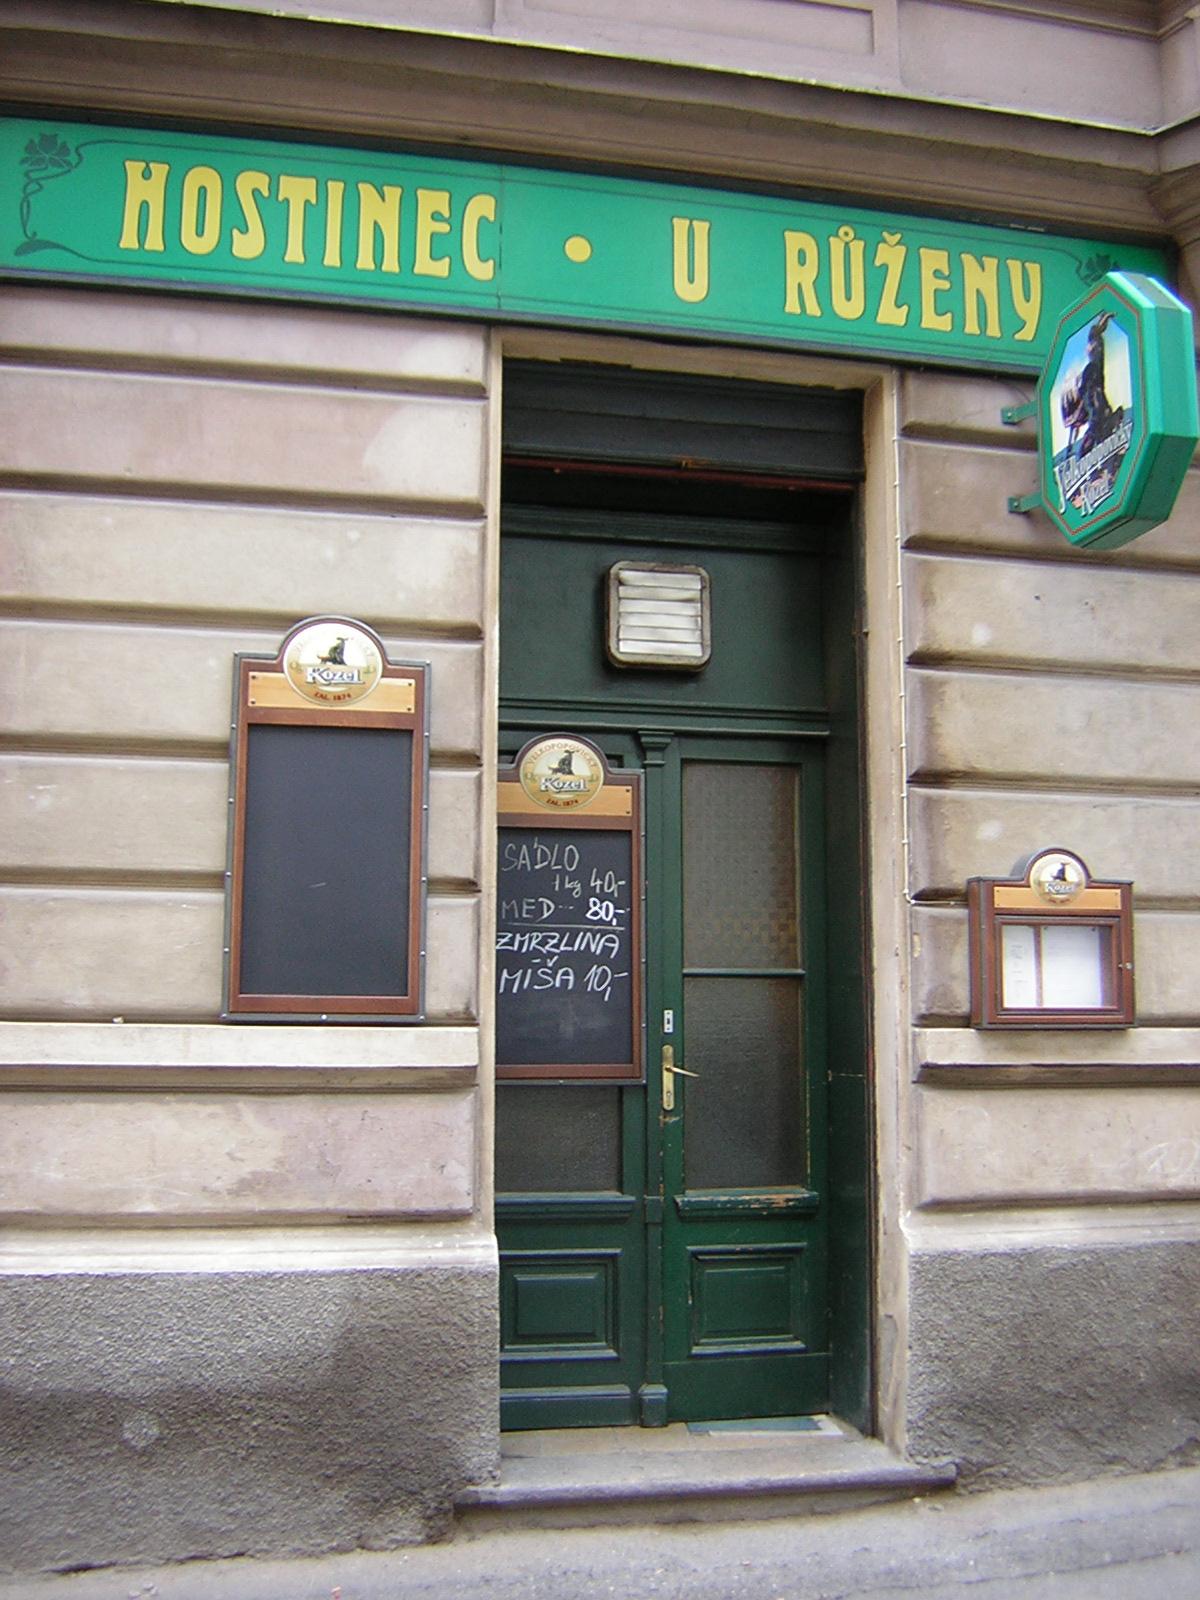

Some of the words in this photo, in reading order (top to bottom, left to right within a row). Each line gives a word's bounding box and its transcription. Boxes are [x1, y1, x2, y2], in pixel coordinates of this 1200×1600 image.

[119, 159, 497, 281] HOSTINEC
[671, 216, 711, 303] U
[783, 225, 1042, 342] RŮŽENY
[305, 667, 366, 686] Kozel
[540, 776, 590, 793] Kozel
[495, 931, 620, 959] ZMRZLINA
